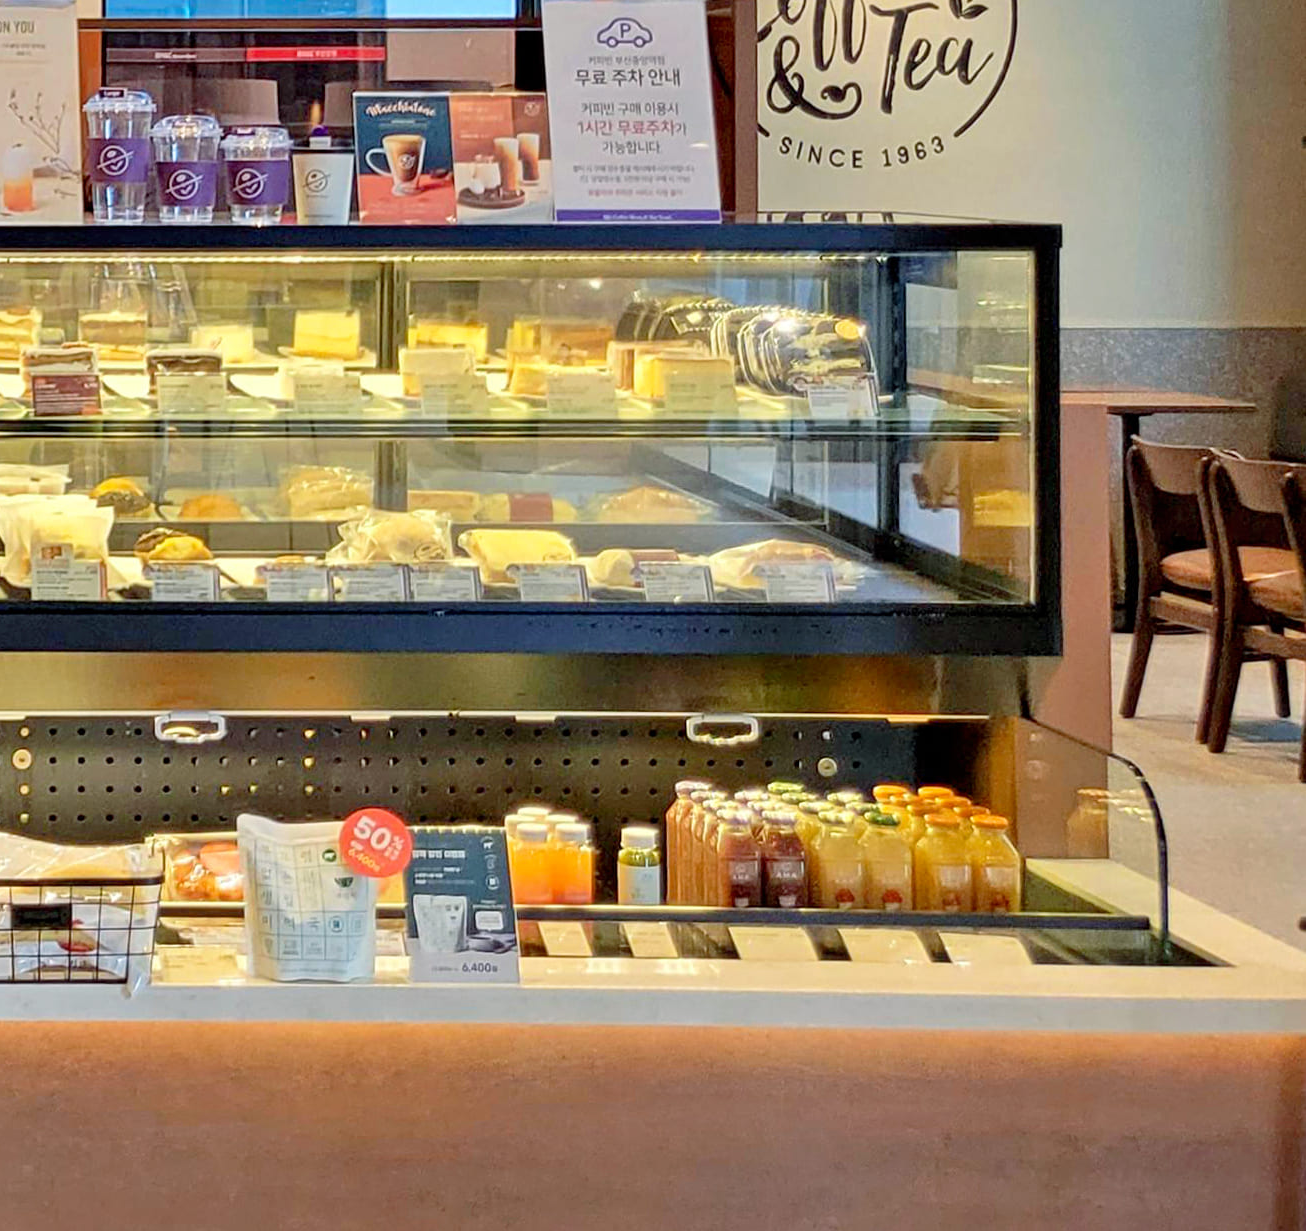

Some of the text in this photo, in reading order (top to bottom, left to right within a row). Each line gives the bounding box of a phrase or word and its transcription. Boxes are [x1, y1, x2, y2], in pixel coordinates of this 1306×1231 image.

[13, 20, 35, 33] YOU
[619, 22, 632, 39] P
[588, 55, 612, 66] 커피빈
[766, 1, 995, 121] & Tea
[575, 69, 681, 87] 무료 주차 안내
[581, 102, 679, 116] 커피빈 구매 이용시
[577, 120, 687, 136] 1시간 무료주차가
[780, 135, 947, 169] SINCE 1963
